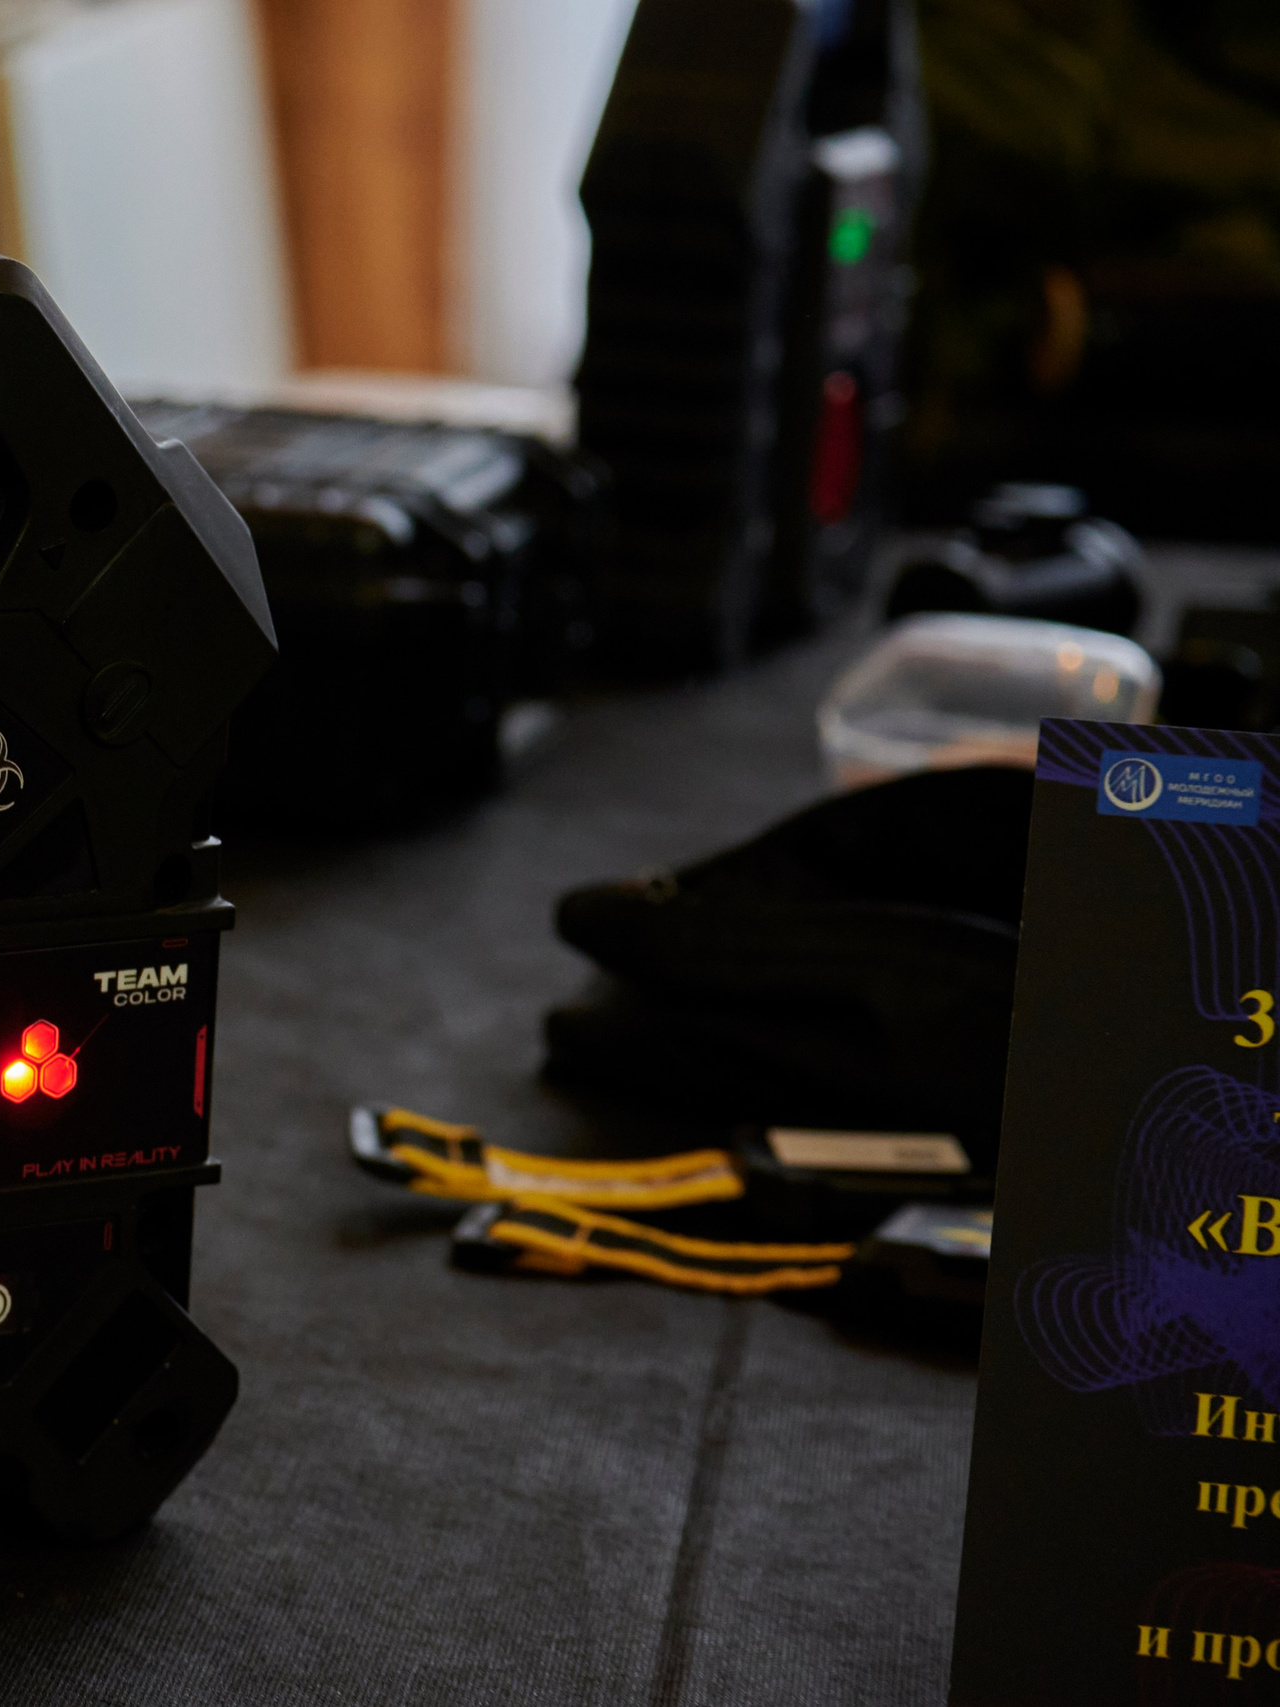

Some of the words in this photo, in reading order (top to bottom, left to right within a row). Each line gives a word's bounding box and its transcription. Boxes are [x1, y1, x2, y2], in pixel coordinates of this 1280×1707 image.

[93, 963, 189, 994] TEAM
[113, 986, 187, 1008] COLOR
[21, 1158, 75, 1180] PLAY
[78, 1154, 97, 1172] IN
[100, 1144, 182, 1169] REALITY
[1190, 1391, 1280, 1444] Ин
[1136, 1624, 1172, 1659] и
